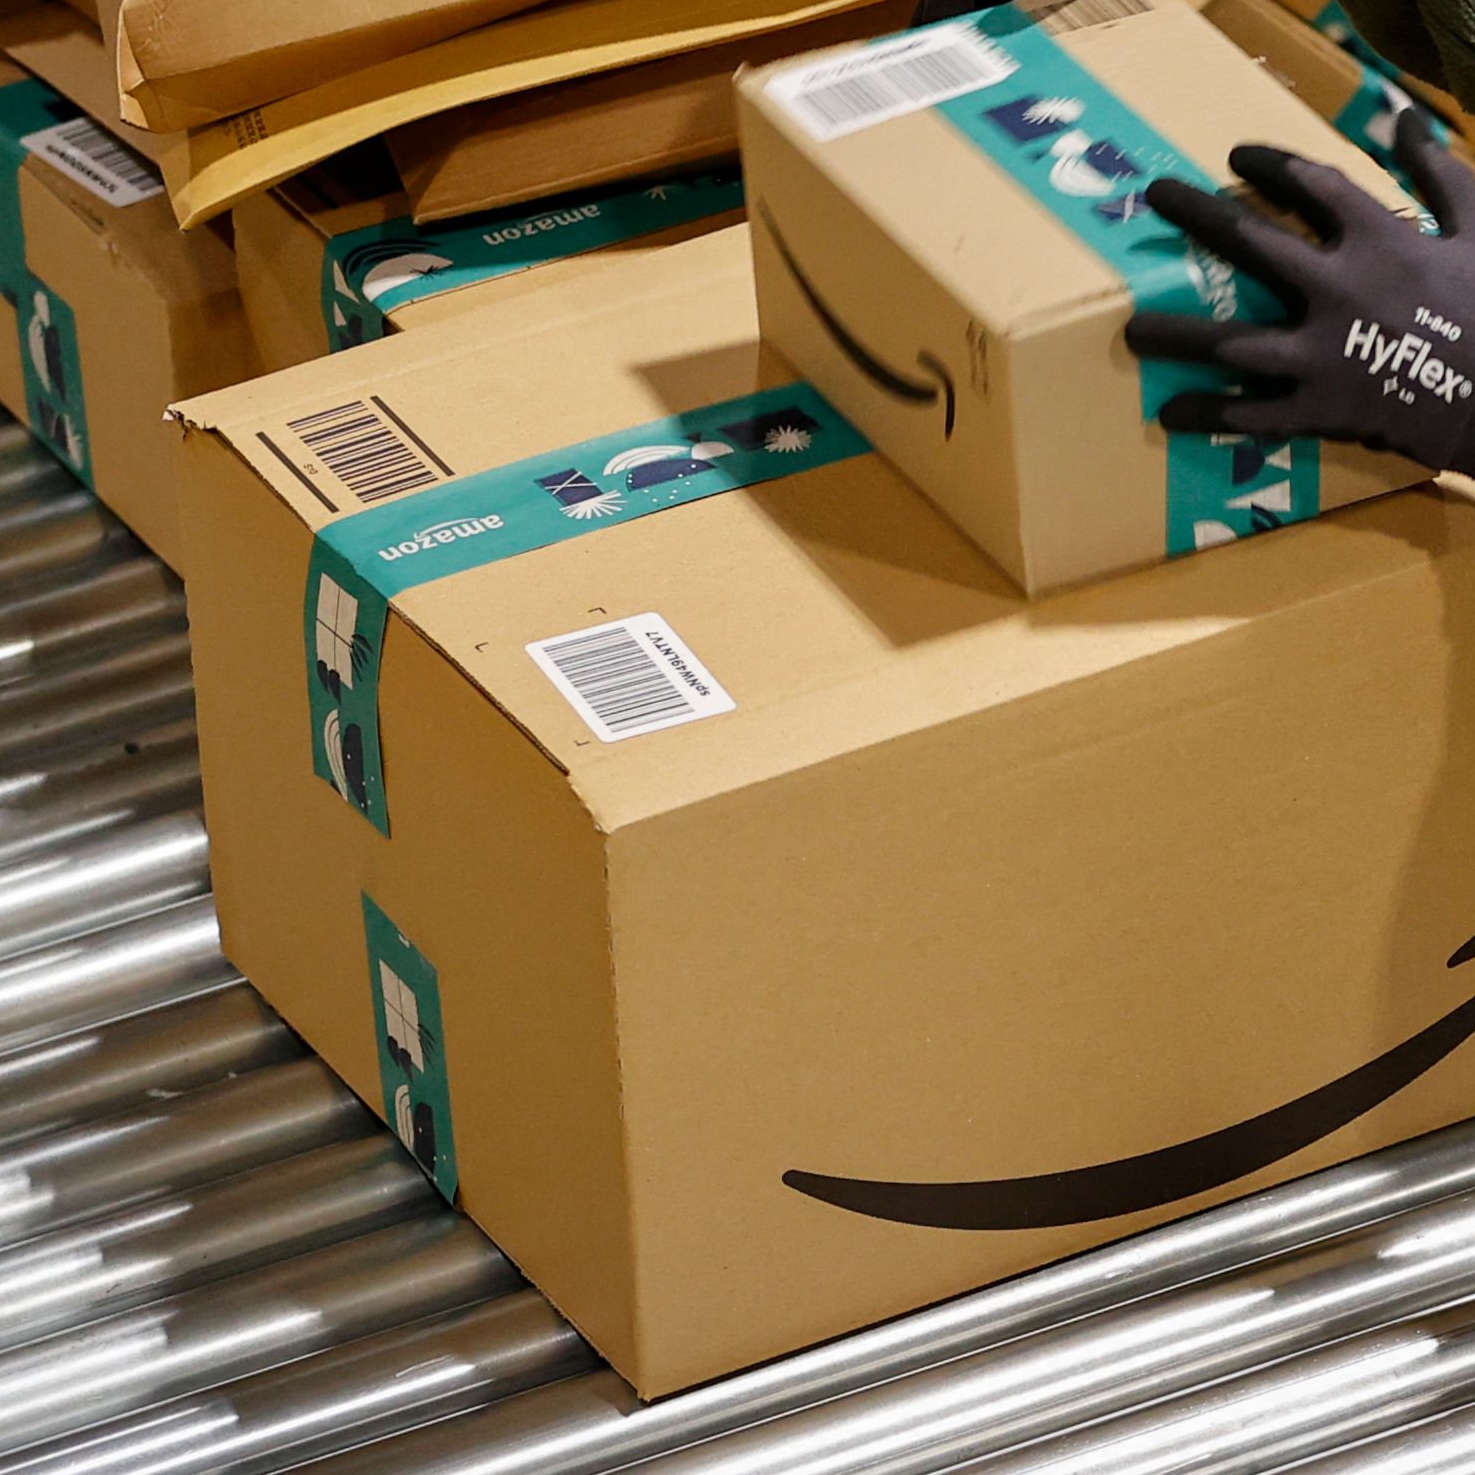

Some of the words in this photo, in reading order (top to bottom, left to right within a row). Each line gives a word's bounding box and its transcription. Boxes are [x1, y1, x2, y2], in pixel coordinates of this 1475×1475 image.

[482, 203, 601, 246] amazon
[1414, 306, 1463, 342] 11-840
[378, 514, 504, 561] amazon
[644, 631, 711, 697] spNW49LNTV7
